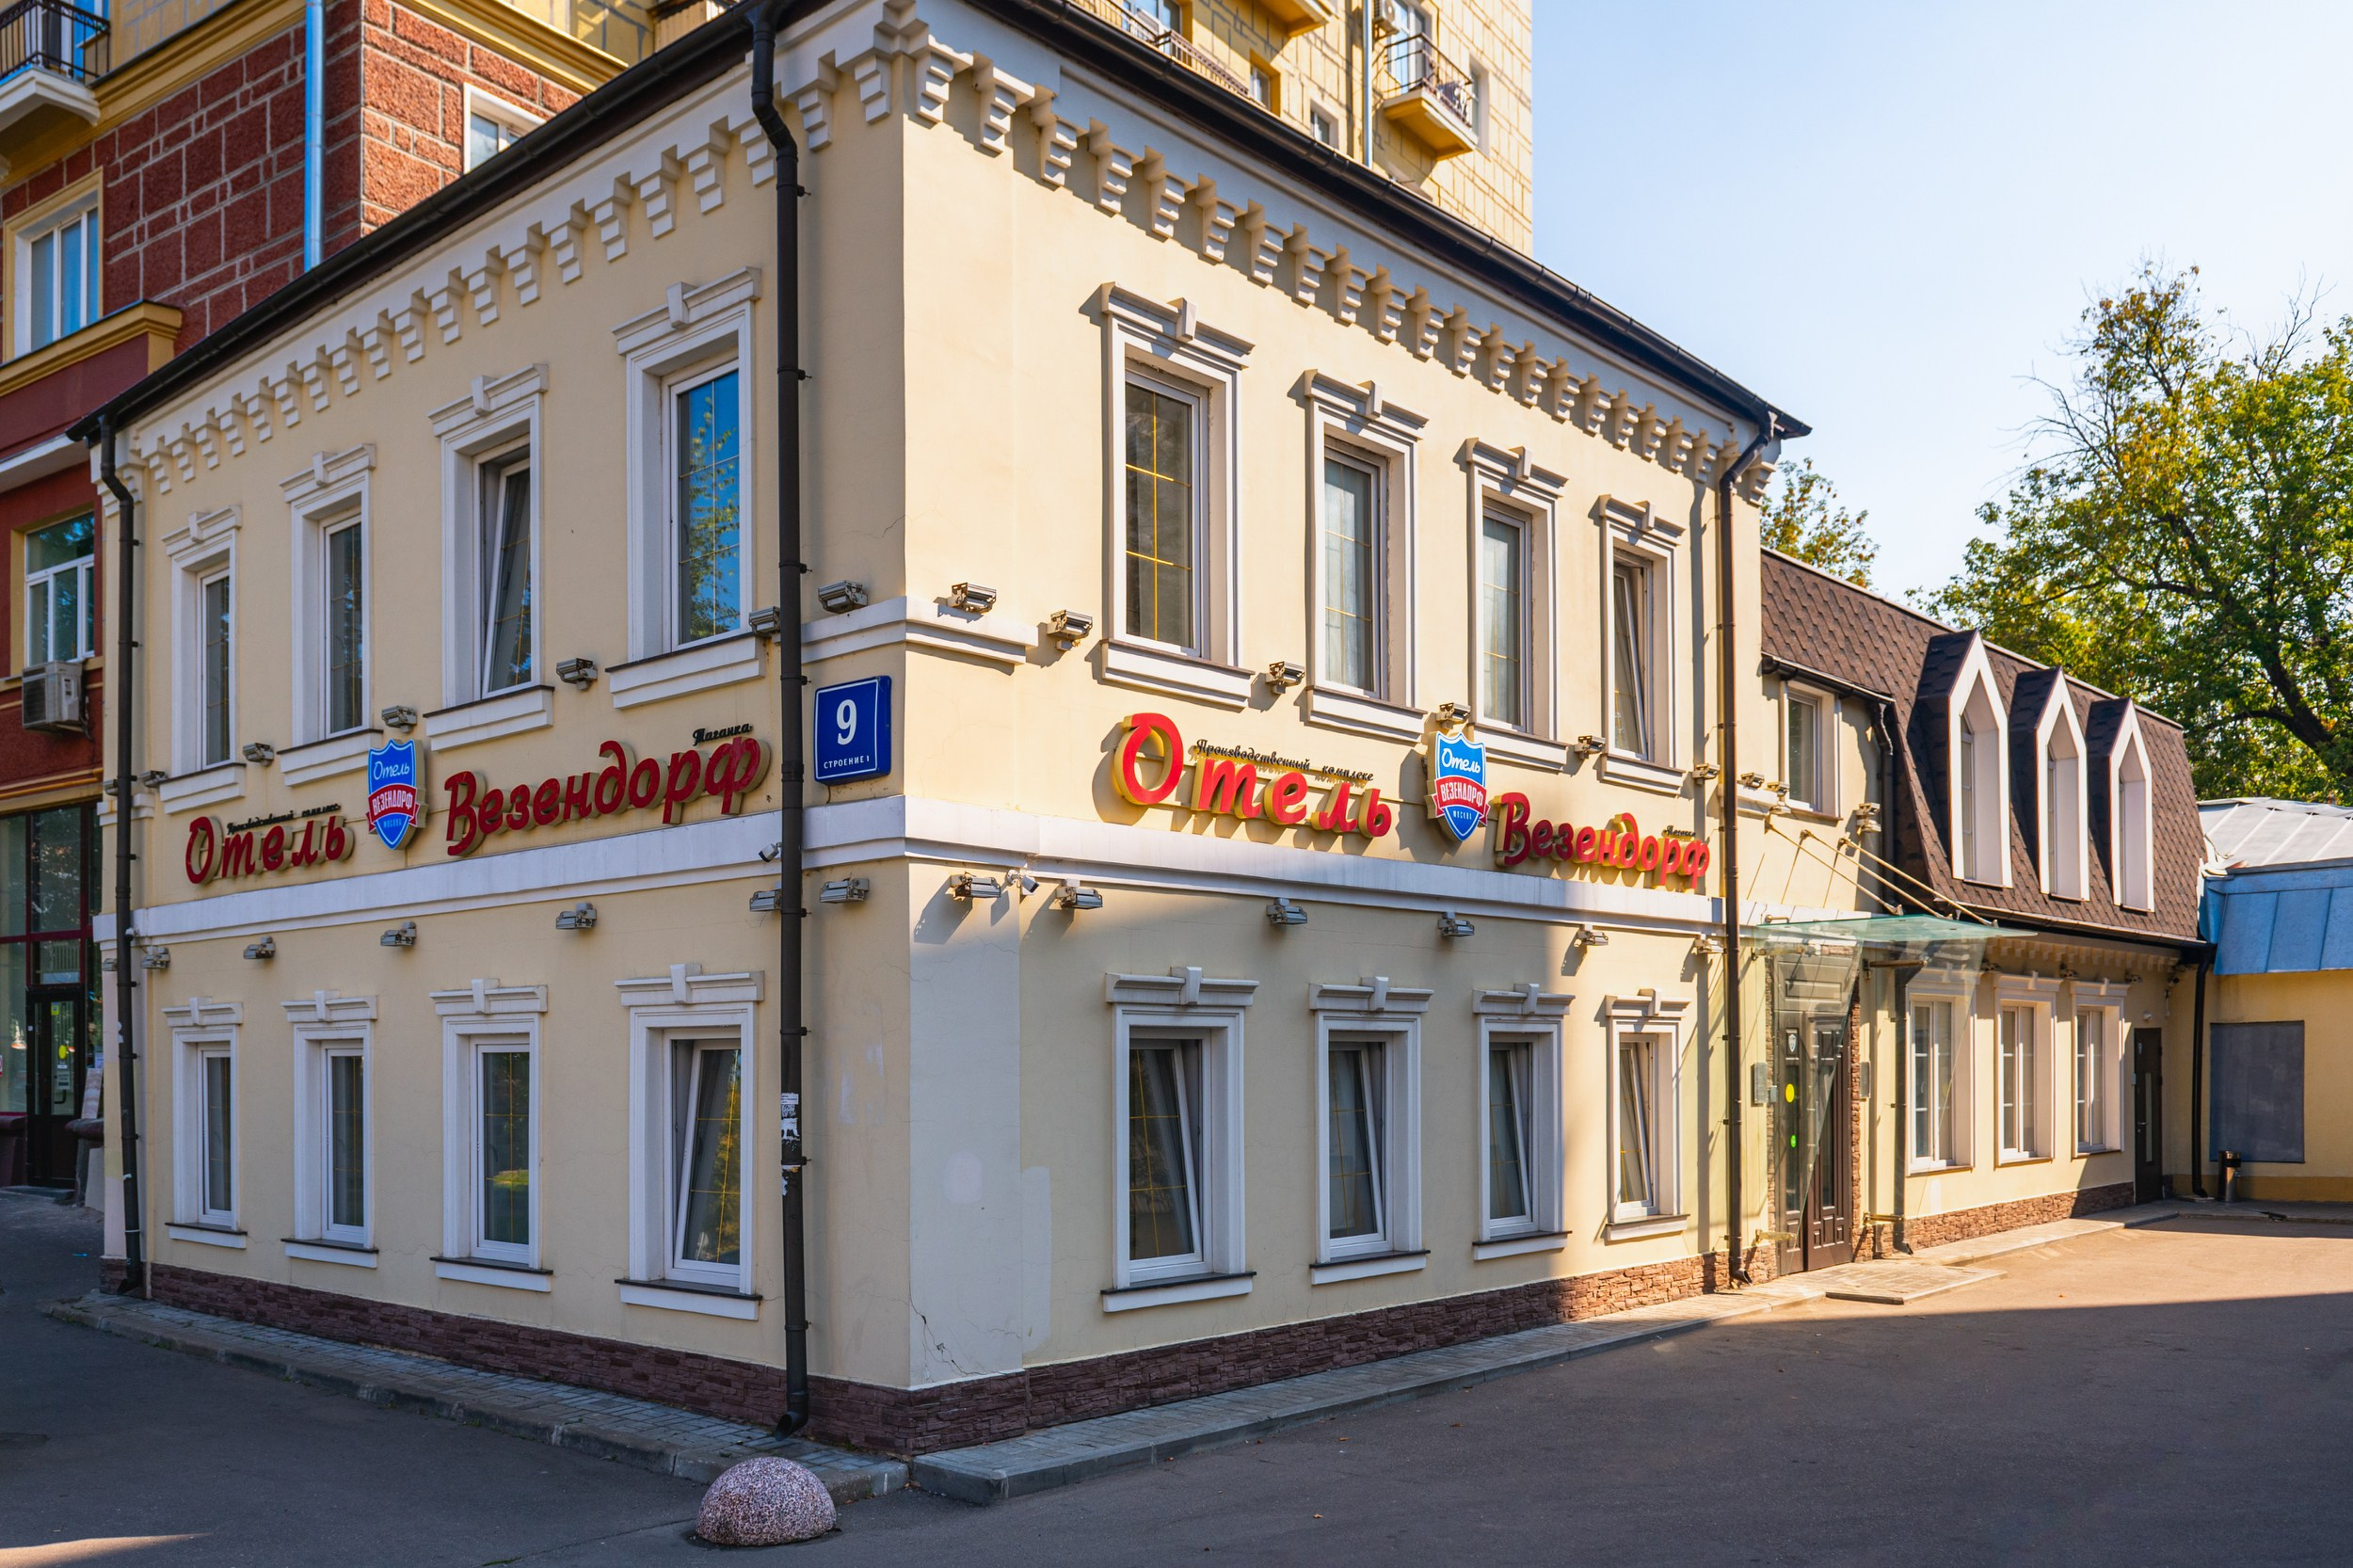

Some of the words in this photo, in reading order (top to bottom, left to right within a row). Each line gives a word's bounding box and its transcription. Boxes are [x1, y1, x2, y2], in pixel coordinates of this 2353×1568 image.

[693, 723, 753, 746] Таганка
[837, 699, 857, 745] 9
[373, 760, 410, 780] Отель
[824, 756, 864, 769] СТРОЕНИЕ
[1441, 748, 1481, 774] Отель
[372, 790, 413, 816] ВЕЗЕНДОРФ
[1116, 712, 1393, 838] Отель
[1495, 792, 1710, 888] Везендорф
[1440, 781, 1484, 808] ВЕЗЕНДОРФ
[185, 815, 352, 885] Отель
[444, 736, 768, 856] Везендорф
